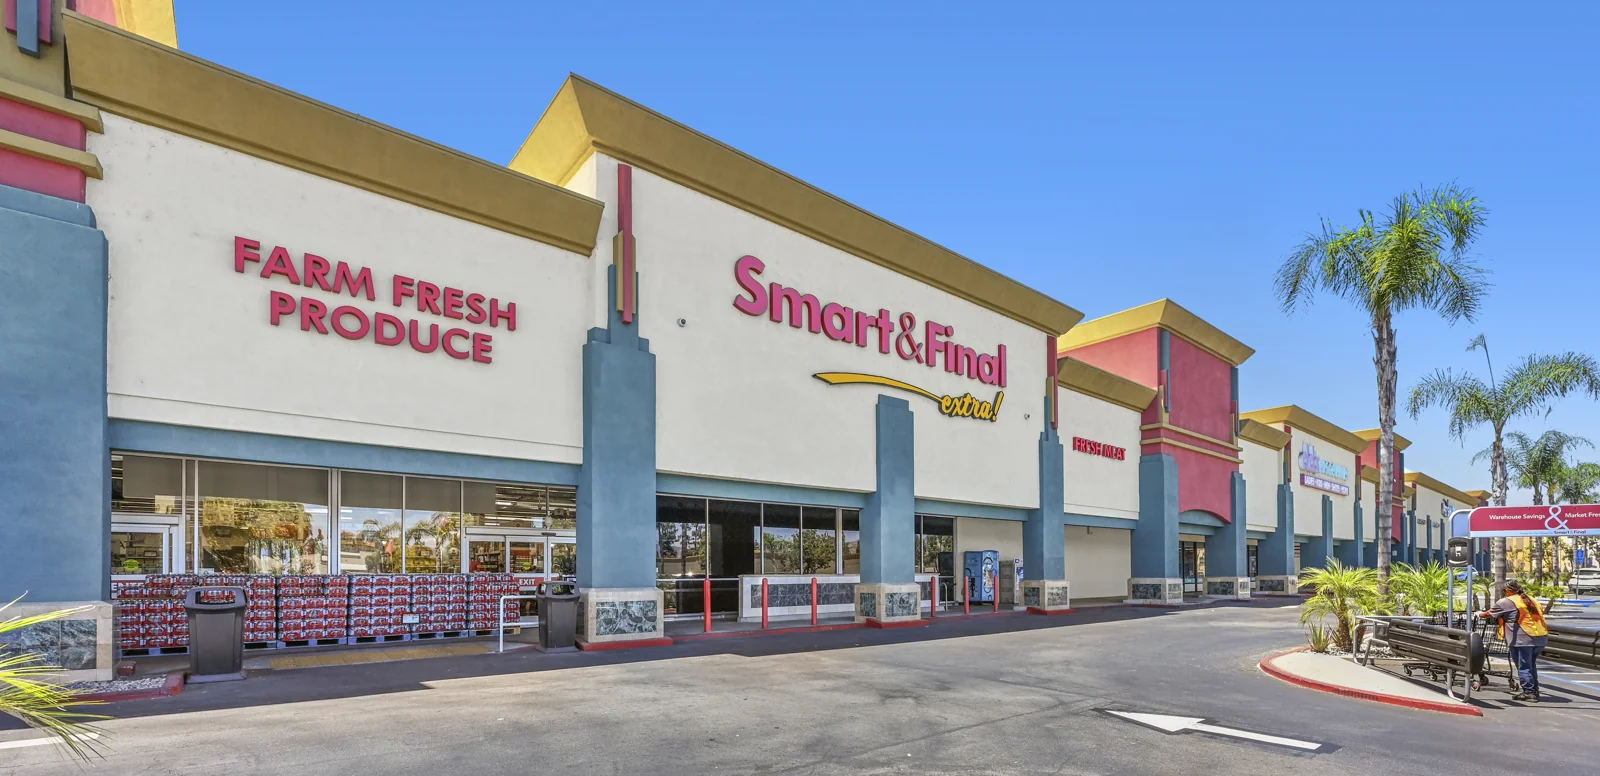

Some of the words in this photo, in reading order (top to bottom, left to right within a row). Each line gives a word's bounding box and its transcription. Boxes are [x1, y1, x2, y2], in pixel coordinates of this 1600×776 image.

[234, 235, 376, 302] FARM
[392, 274, 517, 332] FRESH
[269, 289, 493, 364] PRODUCE
[938, 391, 1005, 423] extra!
[1072, 436, 1102, 457] FRESH
[1101, 444, 1127, 462] MEAT
[1544, 505, 1569, 530] &
[519, 578, 536, 586] EXIT
